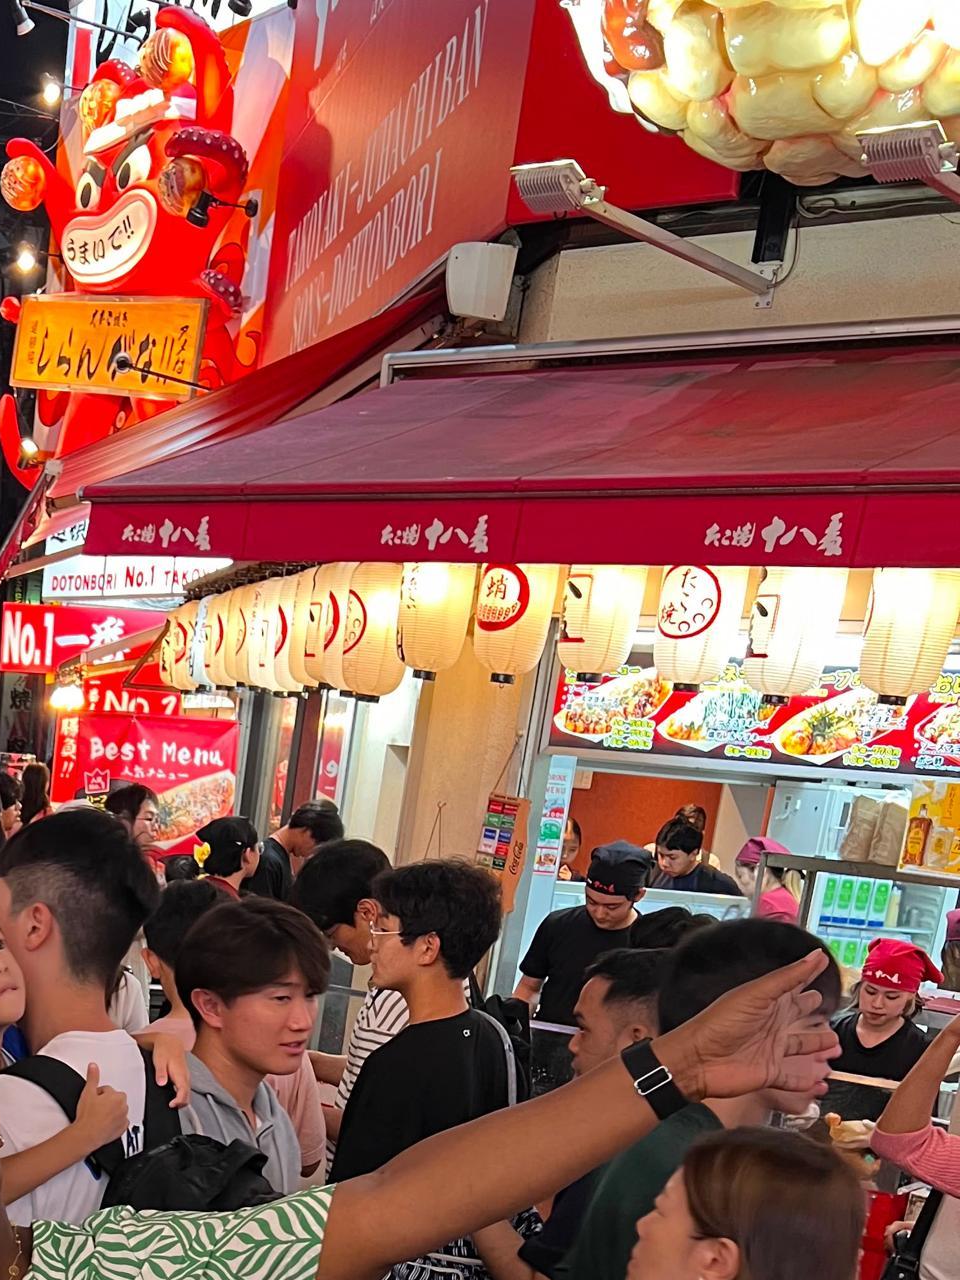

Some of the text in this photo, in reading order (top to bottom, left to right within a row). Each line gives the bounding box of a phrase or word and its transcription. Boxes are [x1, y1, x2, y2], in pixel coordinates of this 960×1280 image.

[51, 565, 208, 592] DOTONBORI No.1 TAKO
[89, 736, 225, 767] Best Menu
